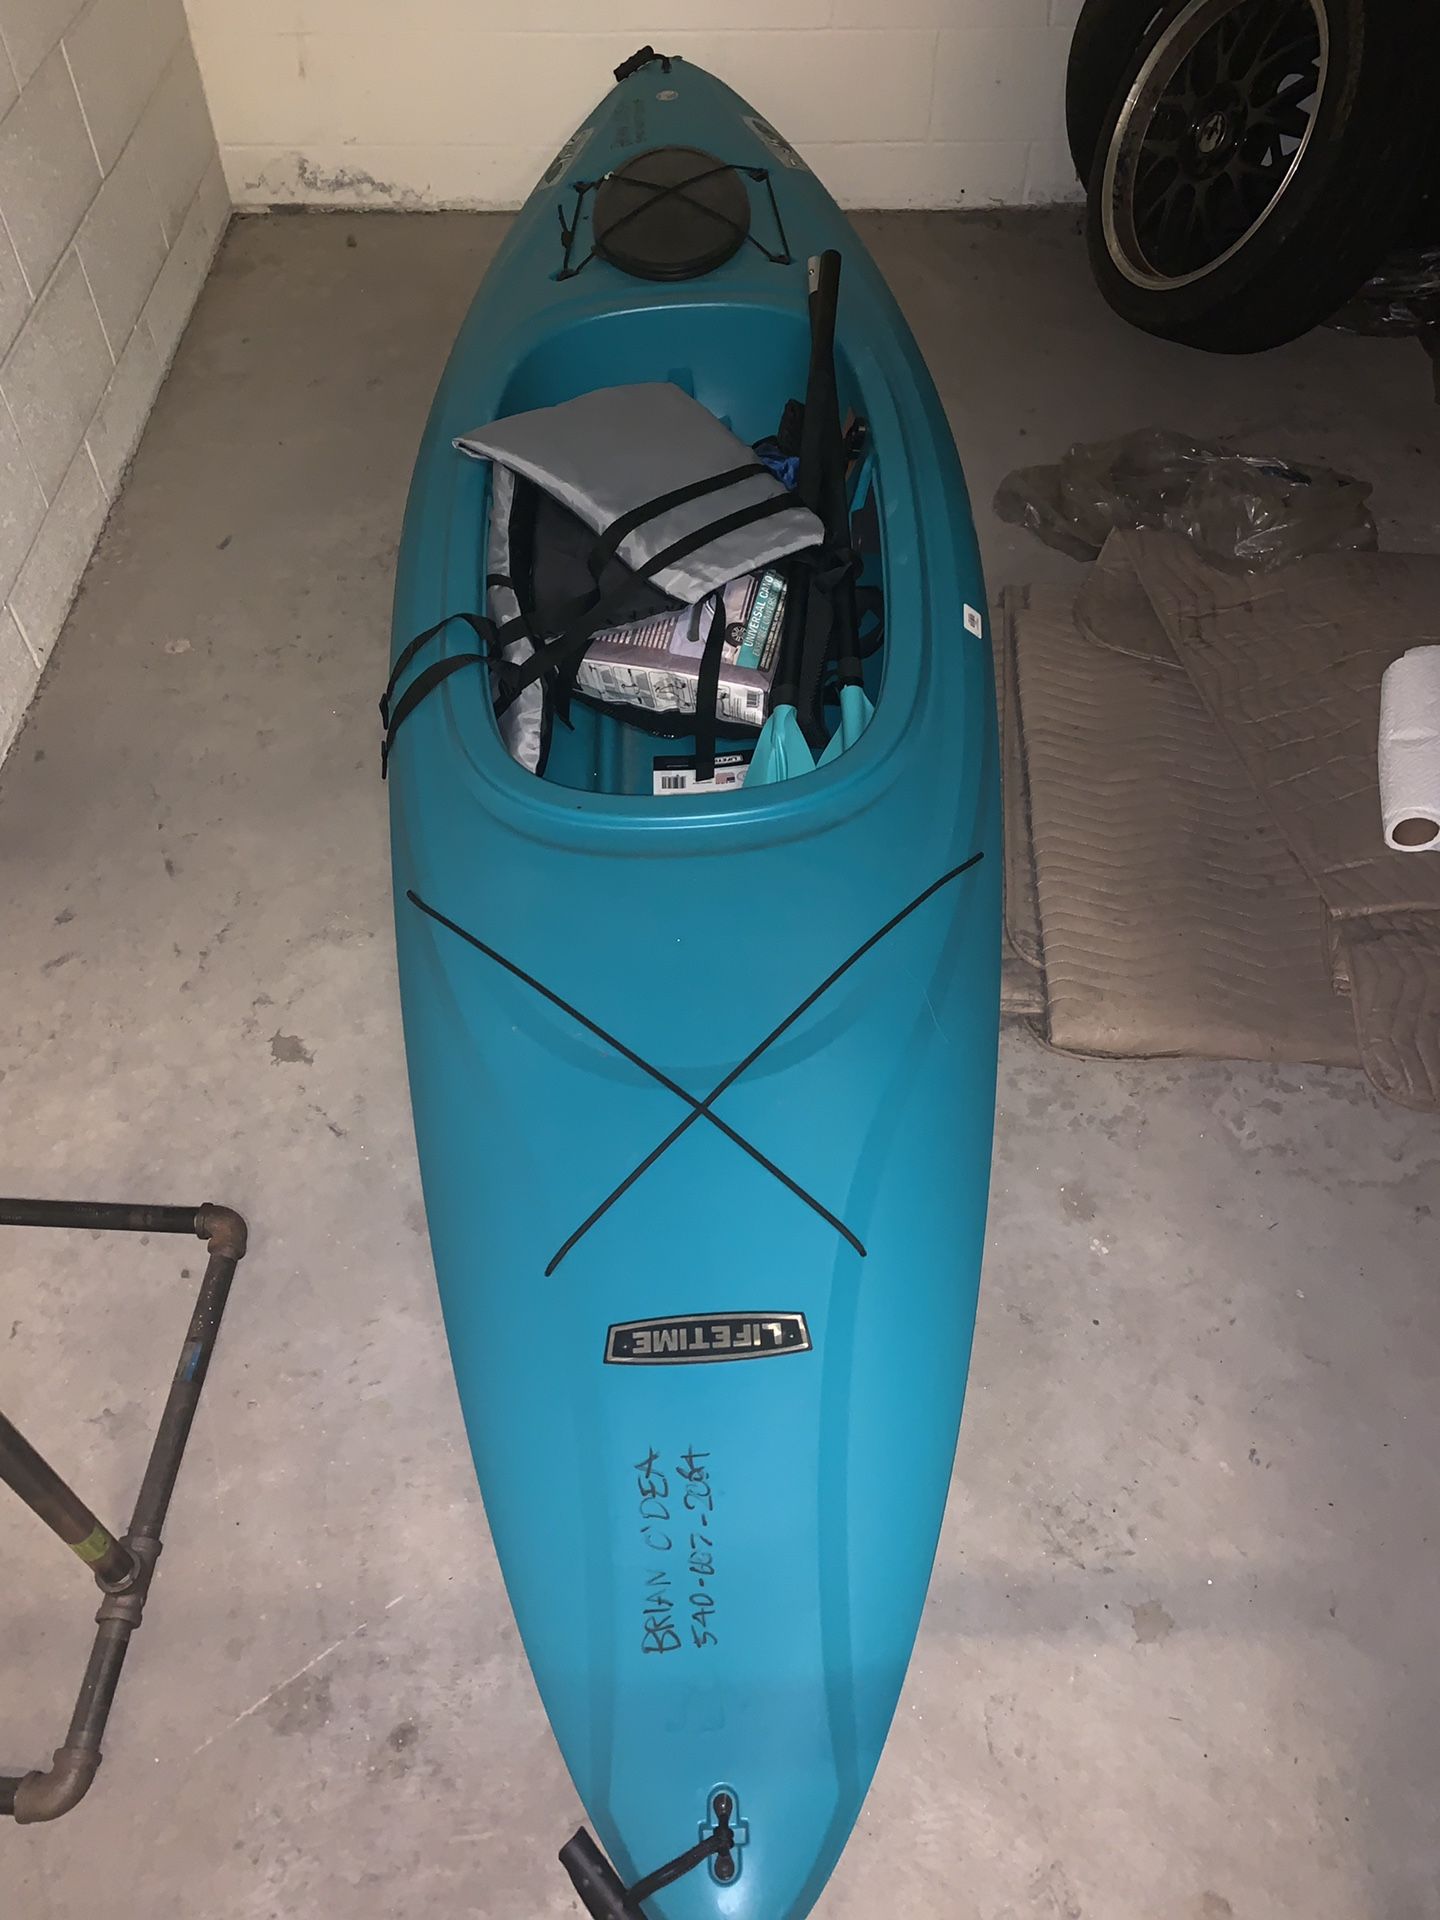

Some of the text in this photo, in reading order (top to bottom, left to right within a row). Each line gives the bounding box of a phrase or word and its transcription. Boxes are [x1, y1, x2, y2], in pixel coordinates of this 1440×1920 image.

[743, 600, 766, 647] UNIVERSAL
[632, 1322, 783, 1354] LIFETIME
[641, 1568, 681, 1654] BRIAN
